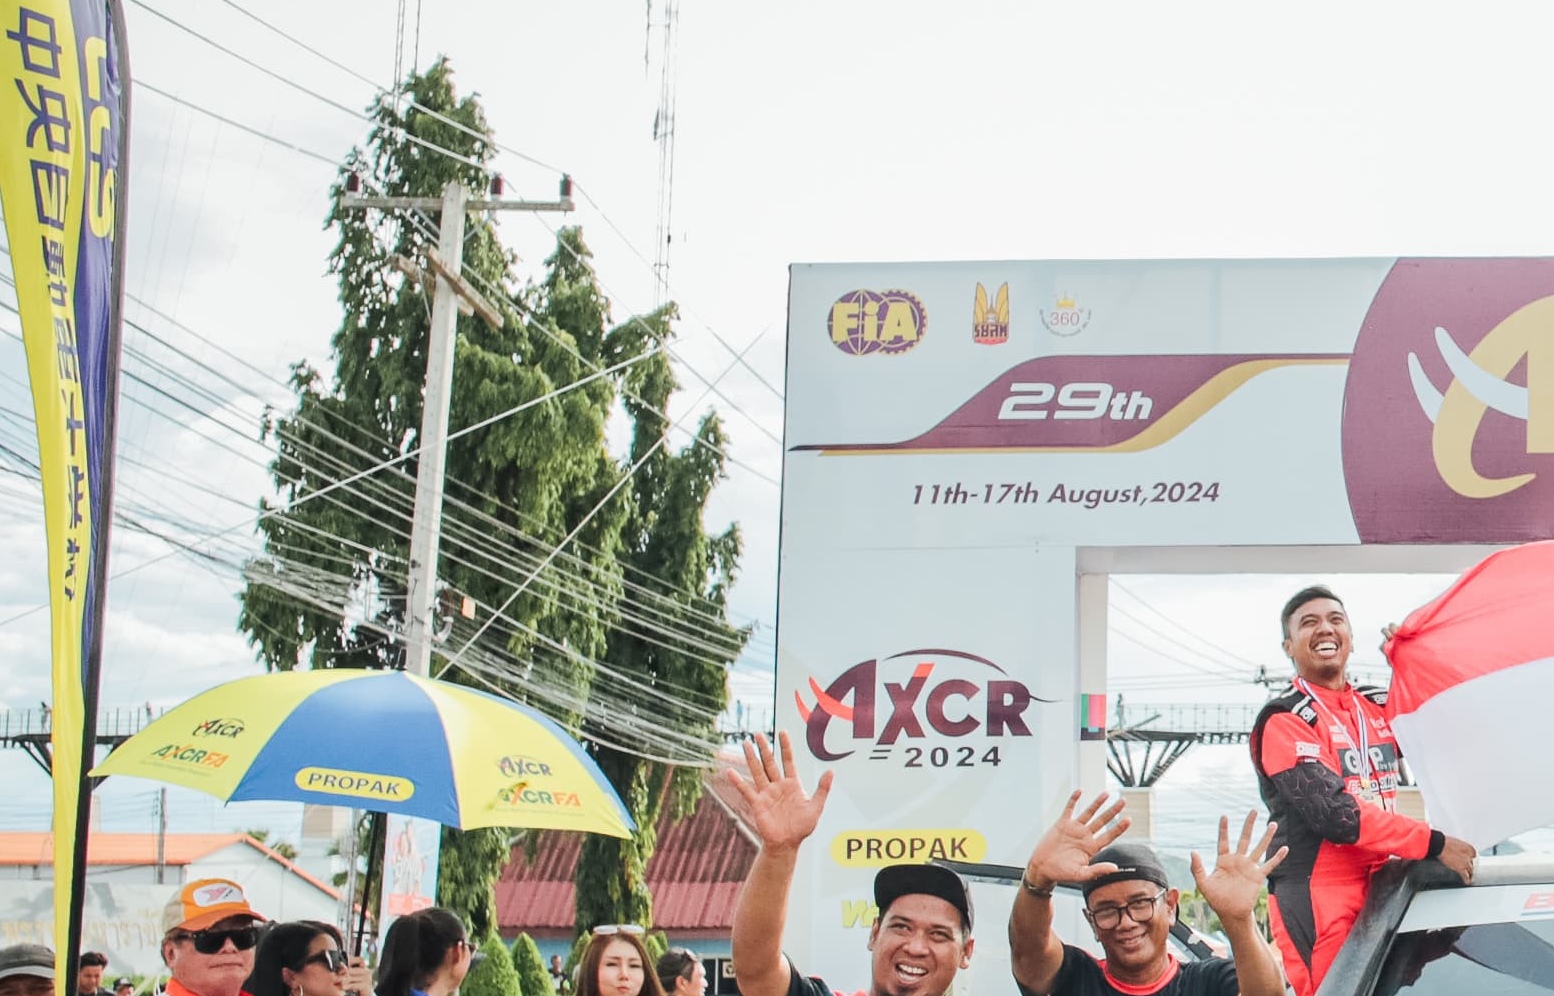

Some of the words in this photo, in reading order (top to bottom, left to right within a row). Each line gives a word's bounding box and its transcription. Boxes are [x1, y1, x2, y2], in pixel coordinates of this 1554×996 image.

[998, 382, 1154, 420] 29th
[796, 658, 1033, 761] AXCR
[192, 717, 245, 739] AXCR
[151, 743, 231, 769] AXCRFA
[497, 755, 553, 778] AXCR
[904, 746, 1002, 768] 2024
[1344, 746, 1384, 774] GP
[307, 772, 401, 796] PROPAK
[845, 837, 969, 860] PROPAK
